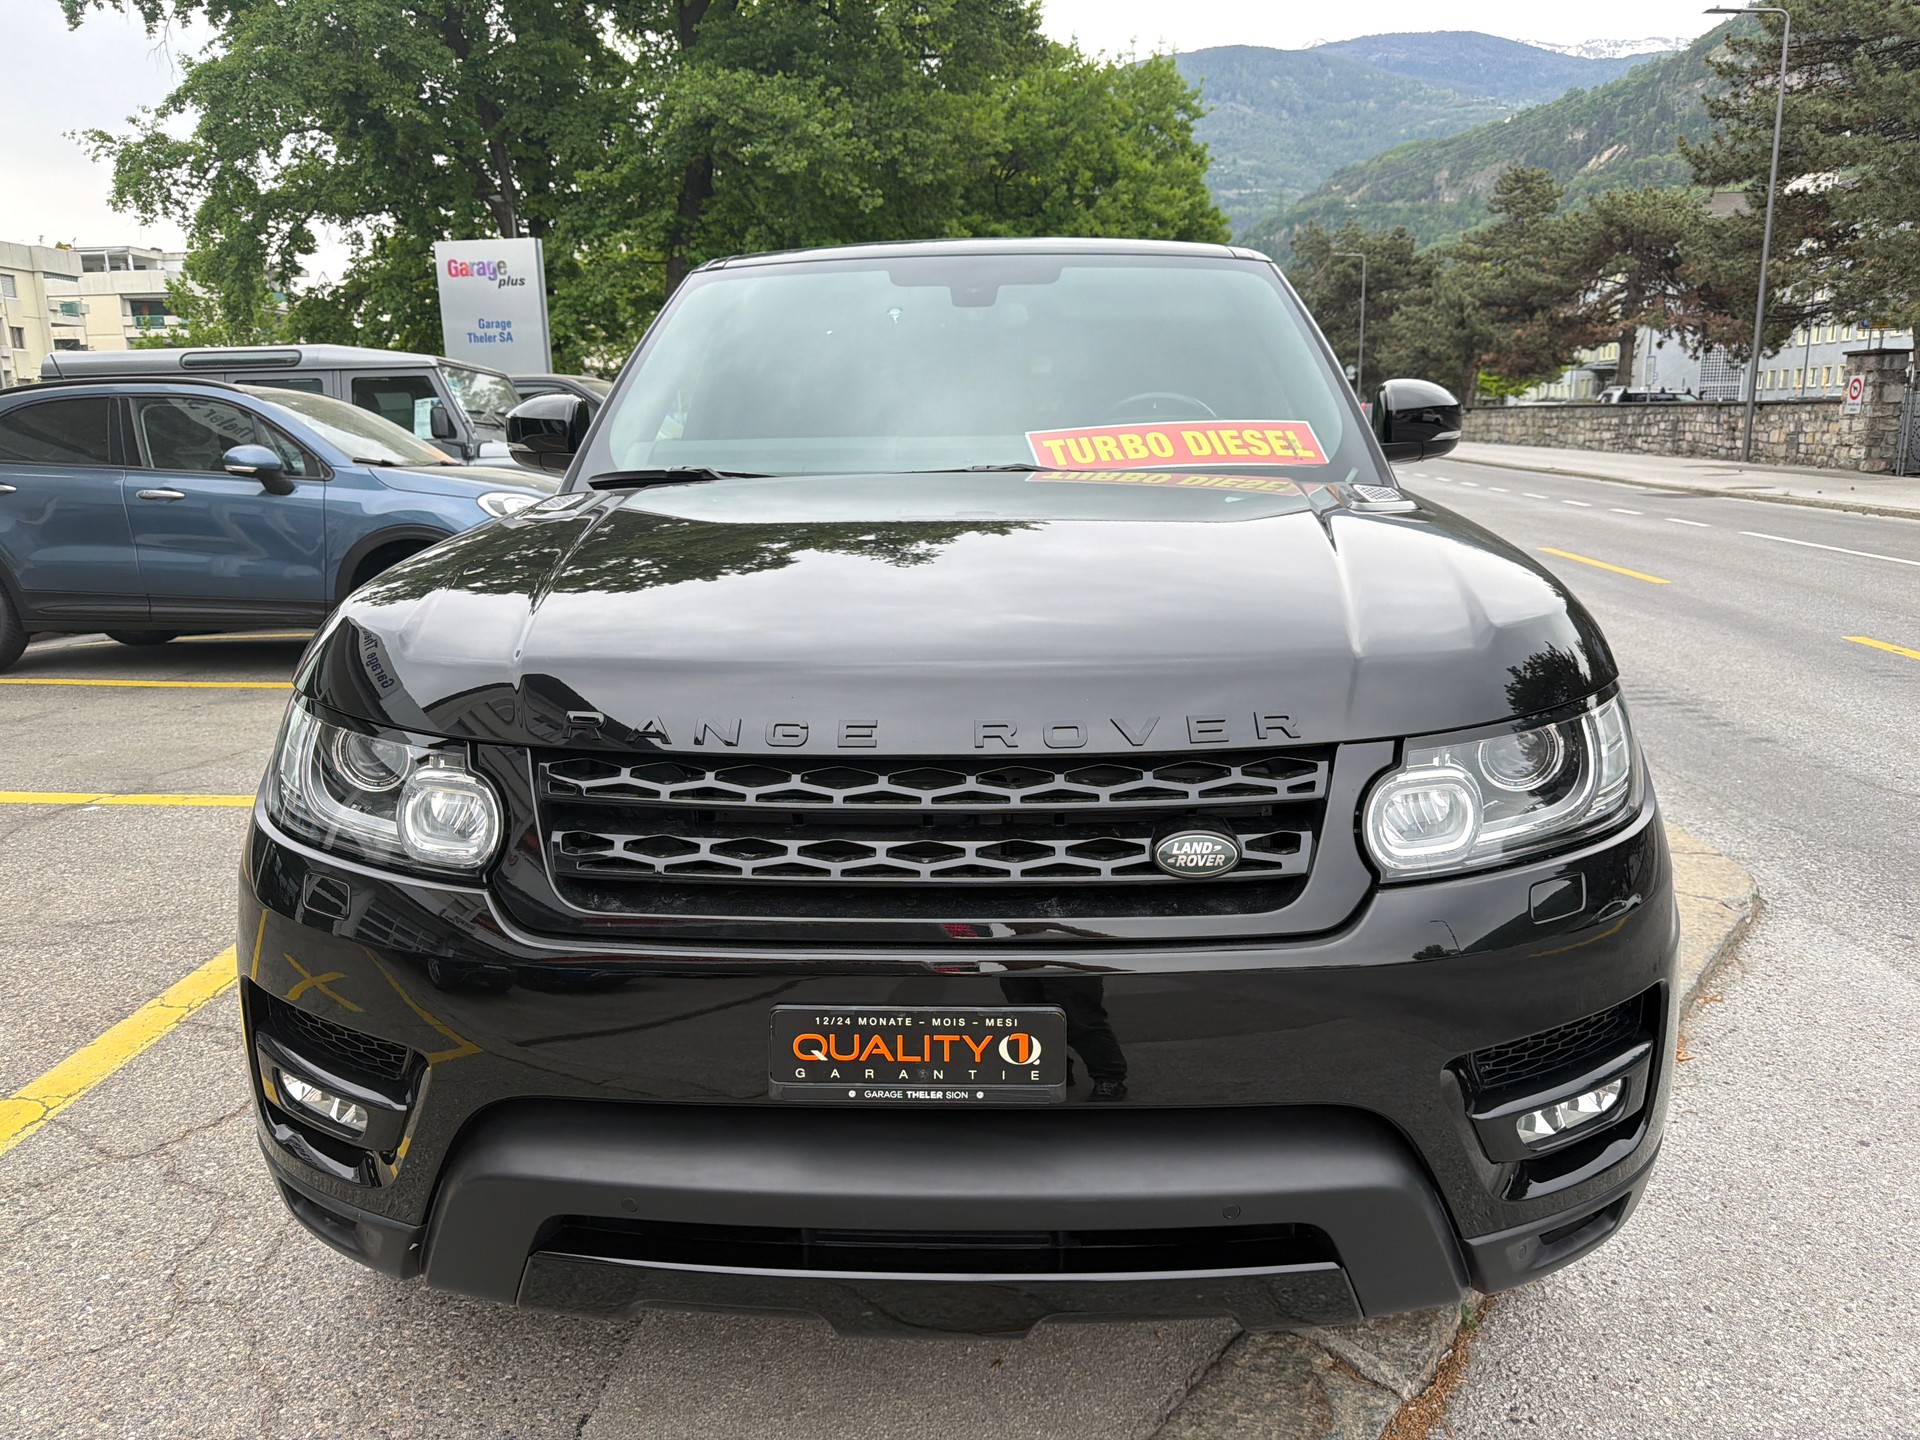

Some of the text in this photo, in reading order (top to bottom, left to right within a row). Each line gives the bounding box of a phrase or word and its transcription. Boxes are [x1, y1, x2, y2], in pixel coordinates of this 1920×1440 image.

[447, 259, 507, 281] Garage
[498, 275, 526, 289] plus
[478, 318, 512, 331] Garage
[467, 332, 513, 343] Theler SA
[1043, 429, 1315, 466] TURBO DIESEL
[562, 710, 1301, 749] RANGE ROVER
[1172, 842, 1213, 854] LAND
[1175, 854, 1225, 867] ROVER
[815, 1017, 851, 1026] 12/24
[858, 1017, 912, 1027] MONATE
[932, 1018, 965, 1027] MOIS
[985, 1018, 1018, 1027] MESI
[792, 1033, 993, 1063] QUALITY
[795, 1068, 1040, 1081] GARANTIE
[864, 1090, 969, 1099] GARAGE THELER SION
